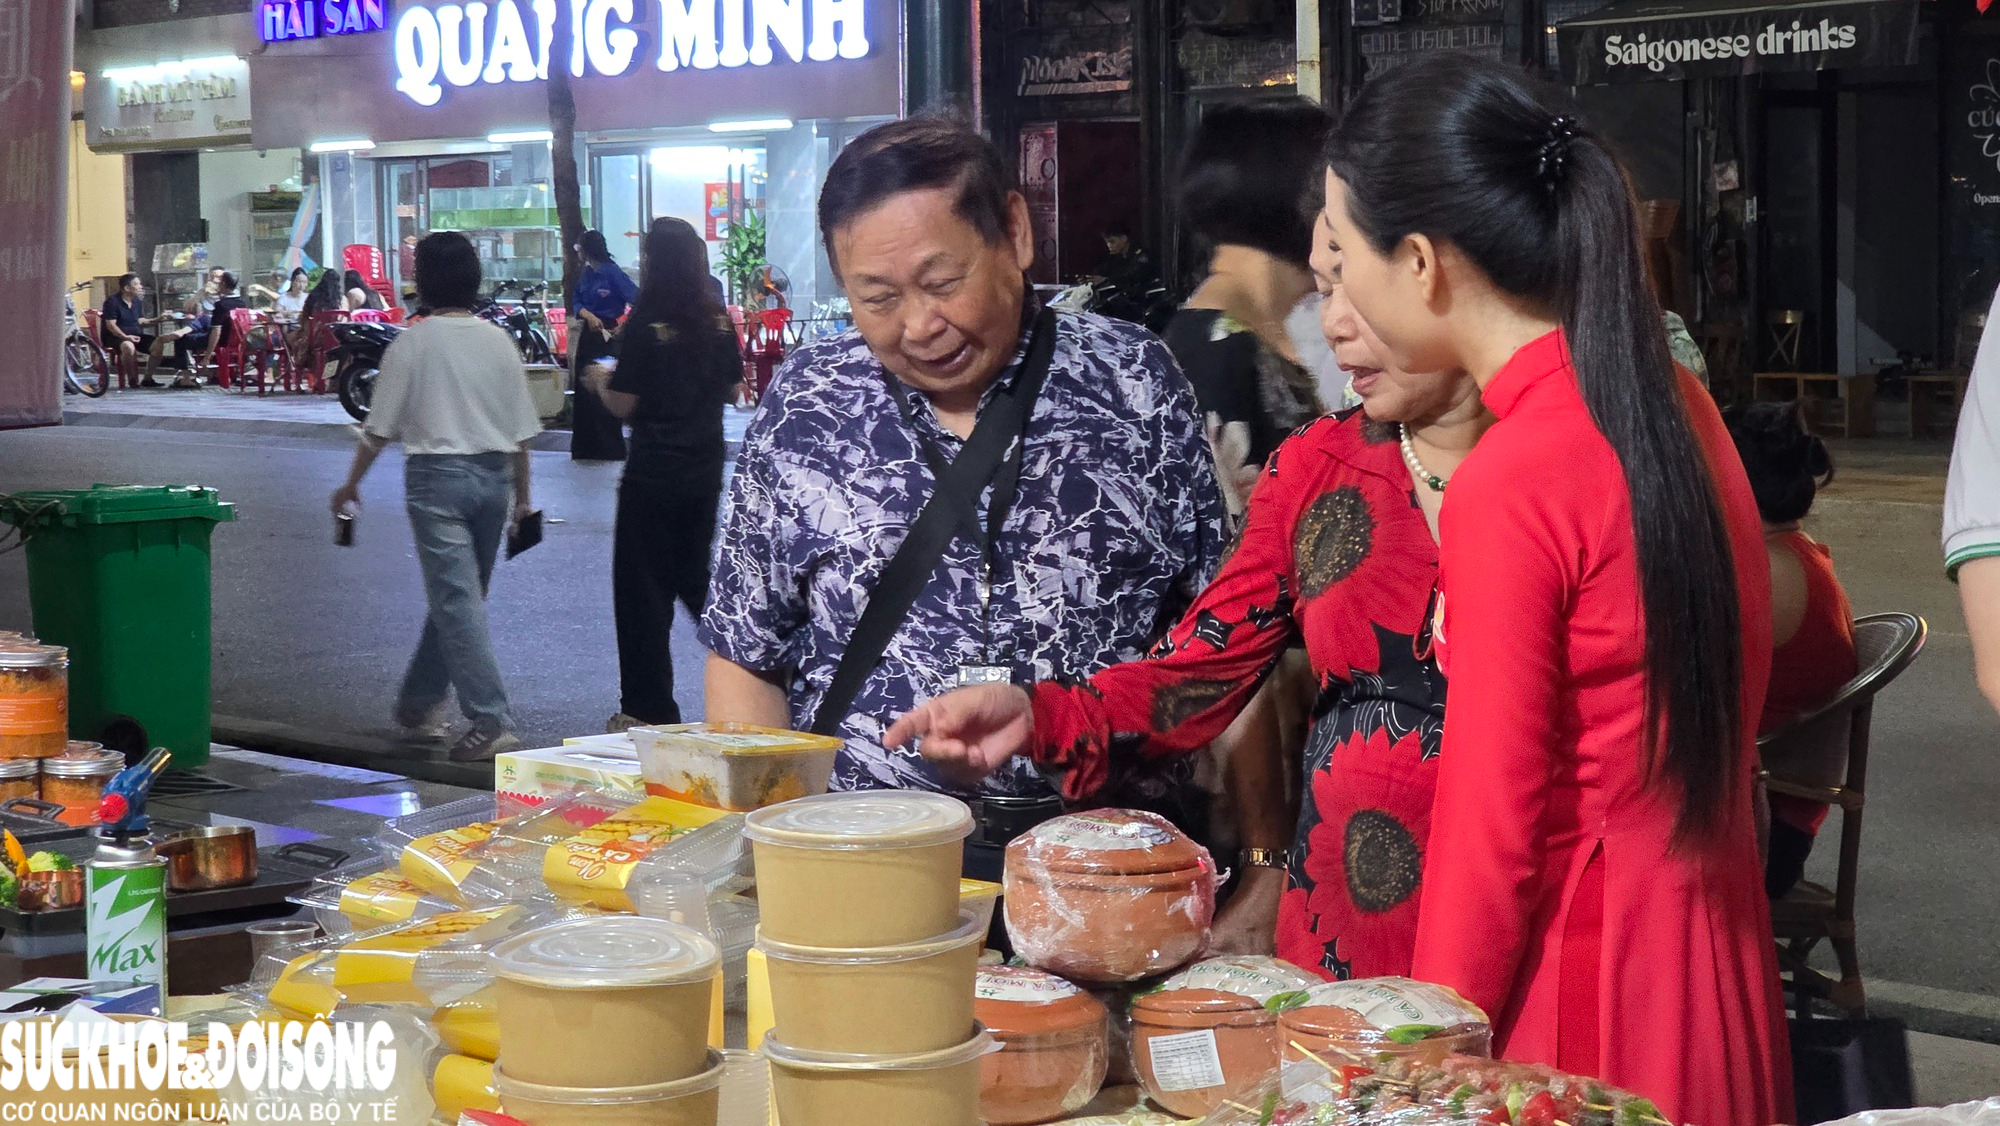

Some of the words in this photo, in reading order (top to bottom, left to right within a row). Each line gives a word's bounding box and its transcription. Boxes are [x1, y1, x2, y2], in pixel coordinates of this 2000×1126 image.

[657, 0, 870, 72] MINH
[1604, 32, 1750, 72] Saigonese
[1756, 19, 1857, 55] drinks
[90, 926, 158, 974] Max
